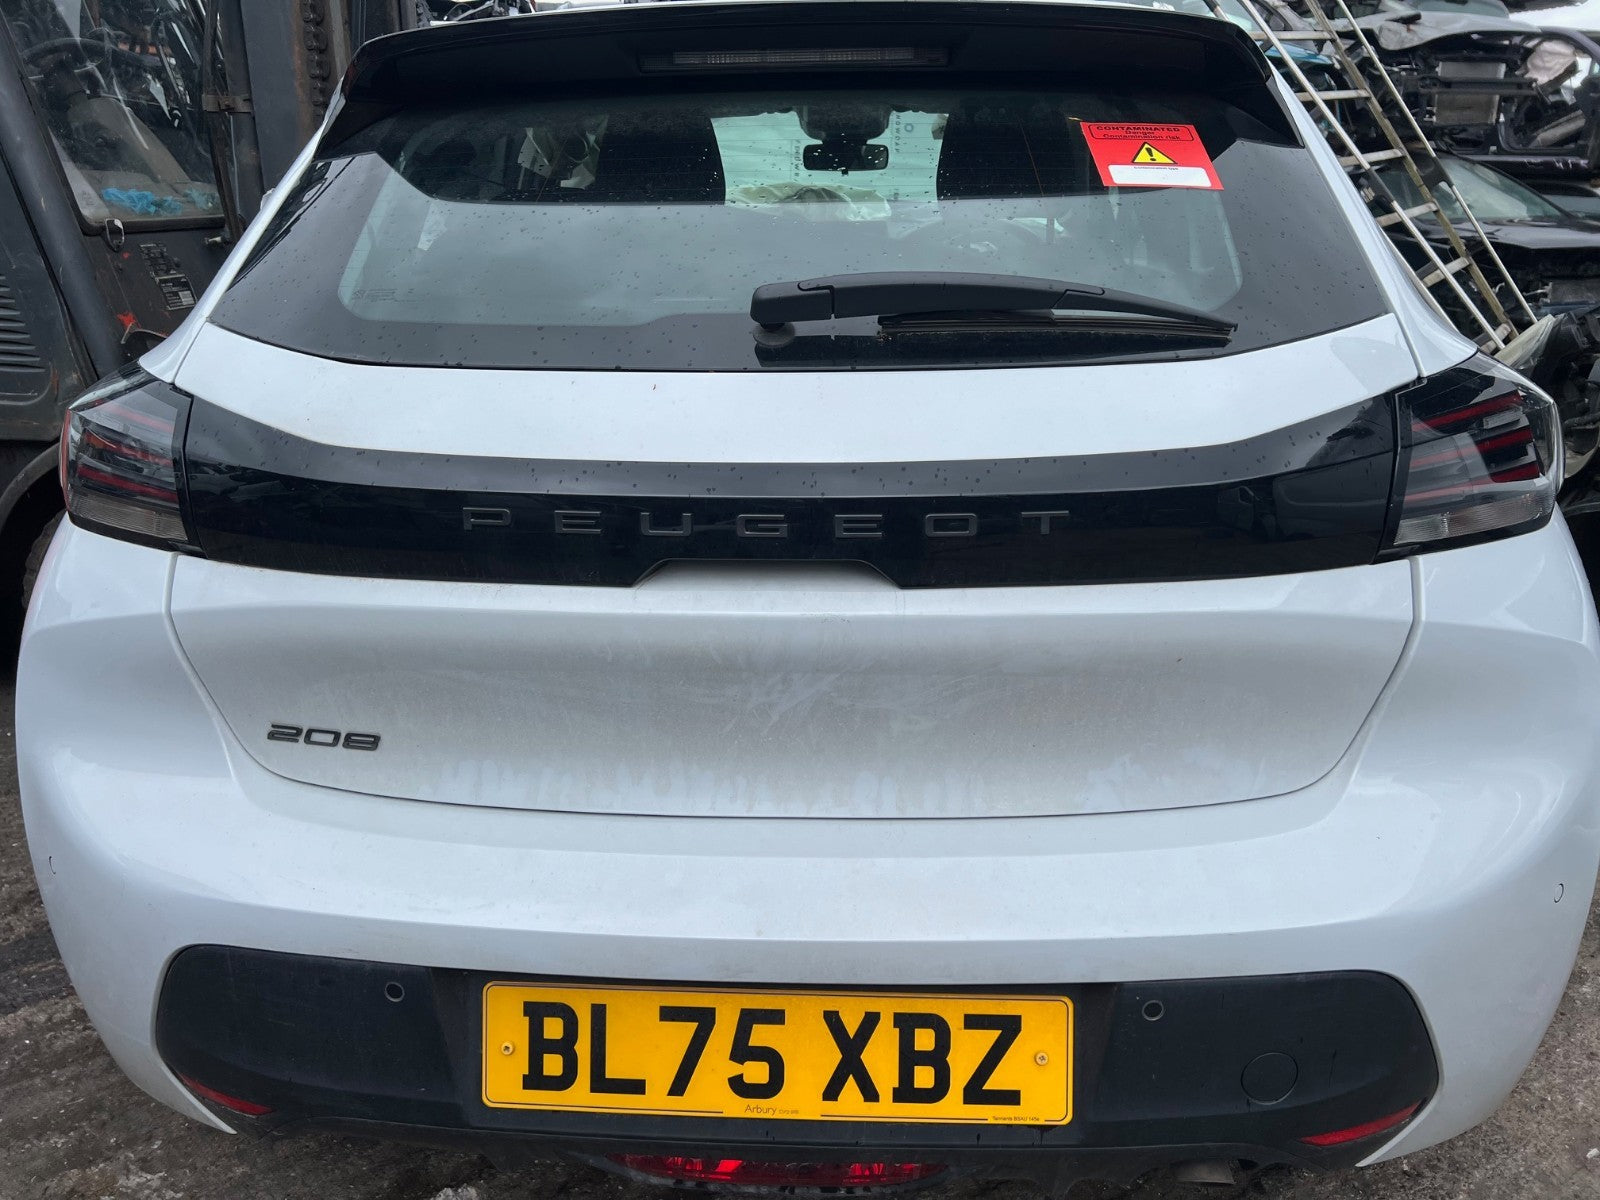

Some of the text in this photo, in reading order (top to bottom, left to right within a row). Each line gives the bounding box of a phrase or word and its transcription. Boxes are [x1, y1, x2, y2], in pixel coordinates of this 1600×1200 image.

[463, 507, 1069, 538] PEUGEOT
[267, 723, 381, 751] 208
[522, 1001, 1023, 1106] BL75 XBZ
[744, 1104, 777, 1116] Arbury
